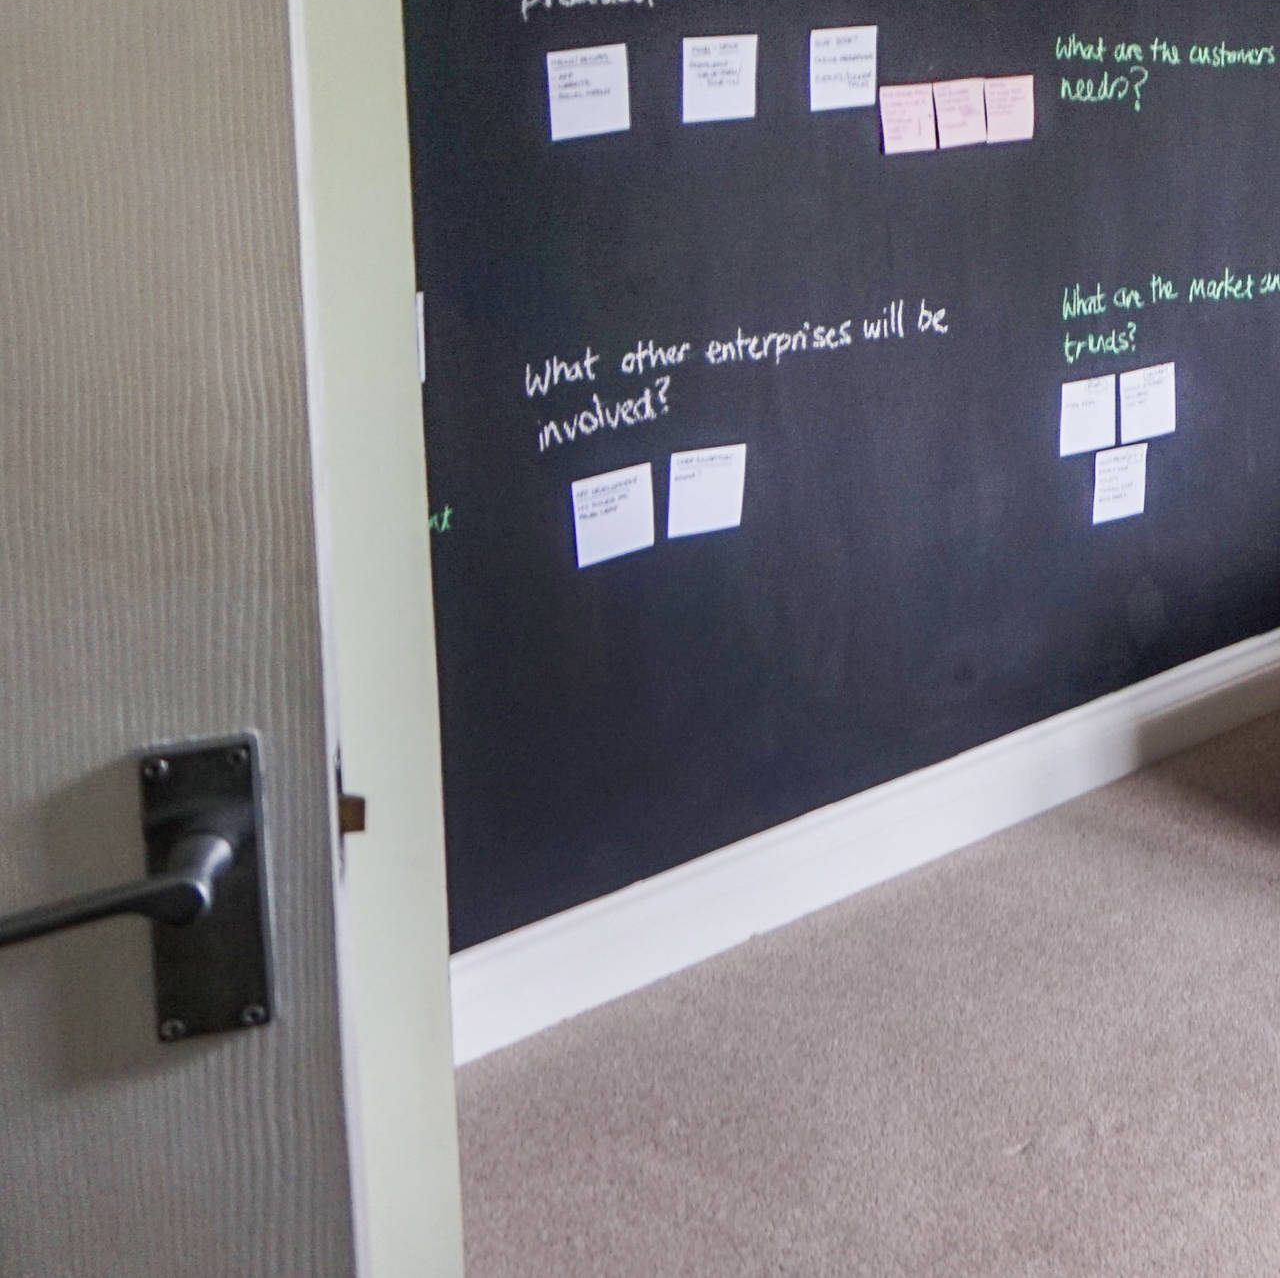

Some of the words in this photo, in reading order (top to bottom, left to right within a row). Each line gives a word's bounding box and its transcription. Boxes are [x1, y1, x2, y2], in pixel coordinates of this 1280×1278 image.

[1055, 33, 1104, 63] What
[1113, 42, 1143, 63] are
[1150, 37, 1181, 65] the
[1188, 40, 1276, 67] customers
[1060, 65, 1149, 113] needs?
[1061, 282, 1106, 321] What
[1113, 286, 1145, 310] are
[1150, 273, 1179, 305] the
[1188, 266, 1254, 303] market
[524, 348, 600, 398] What
[620, 338, 690, 376] other
[704, 321, 853, 365] enterprises
[862, 299, 905, 340] will
[917, 298, 949, 334] be
[537, 376, 673, 452] involved?
